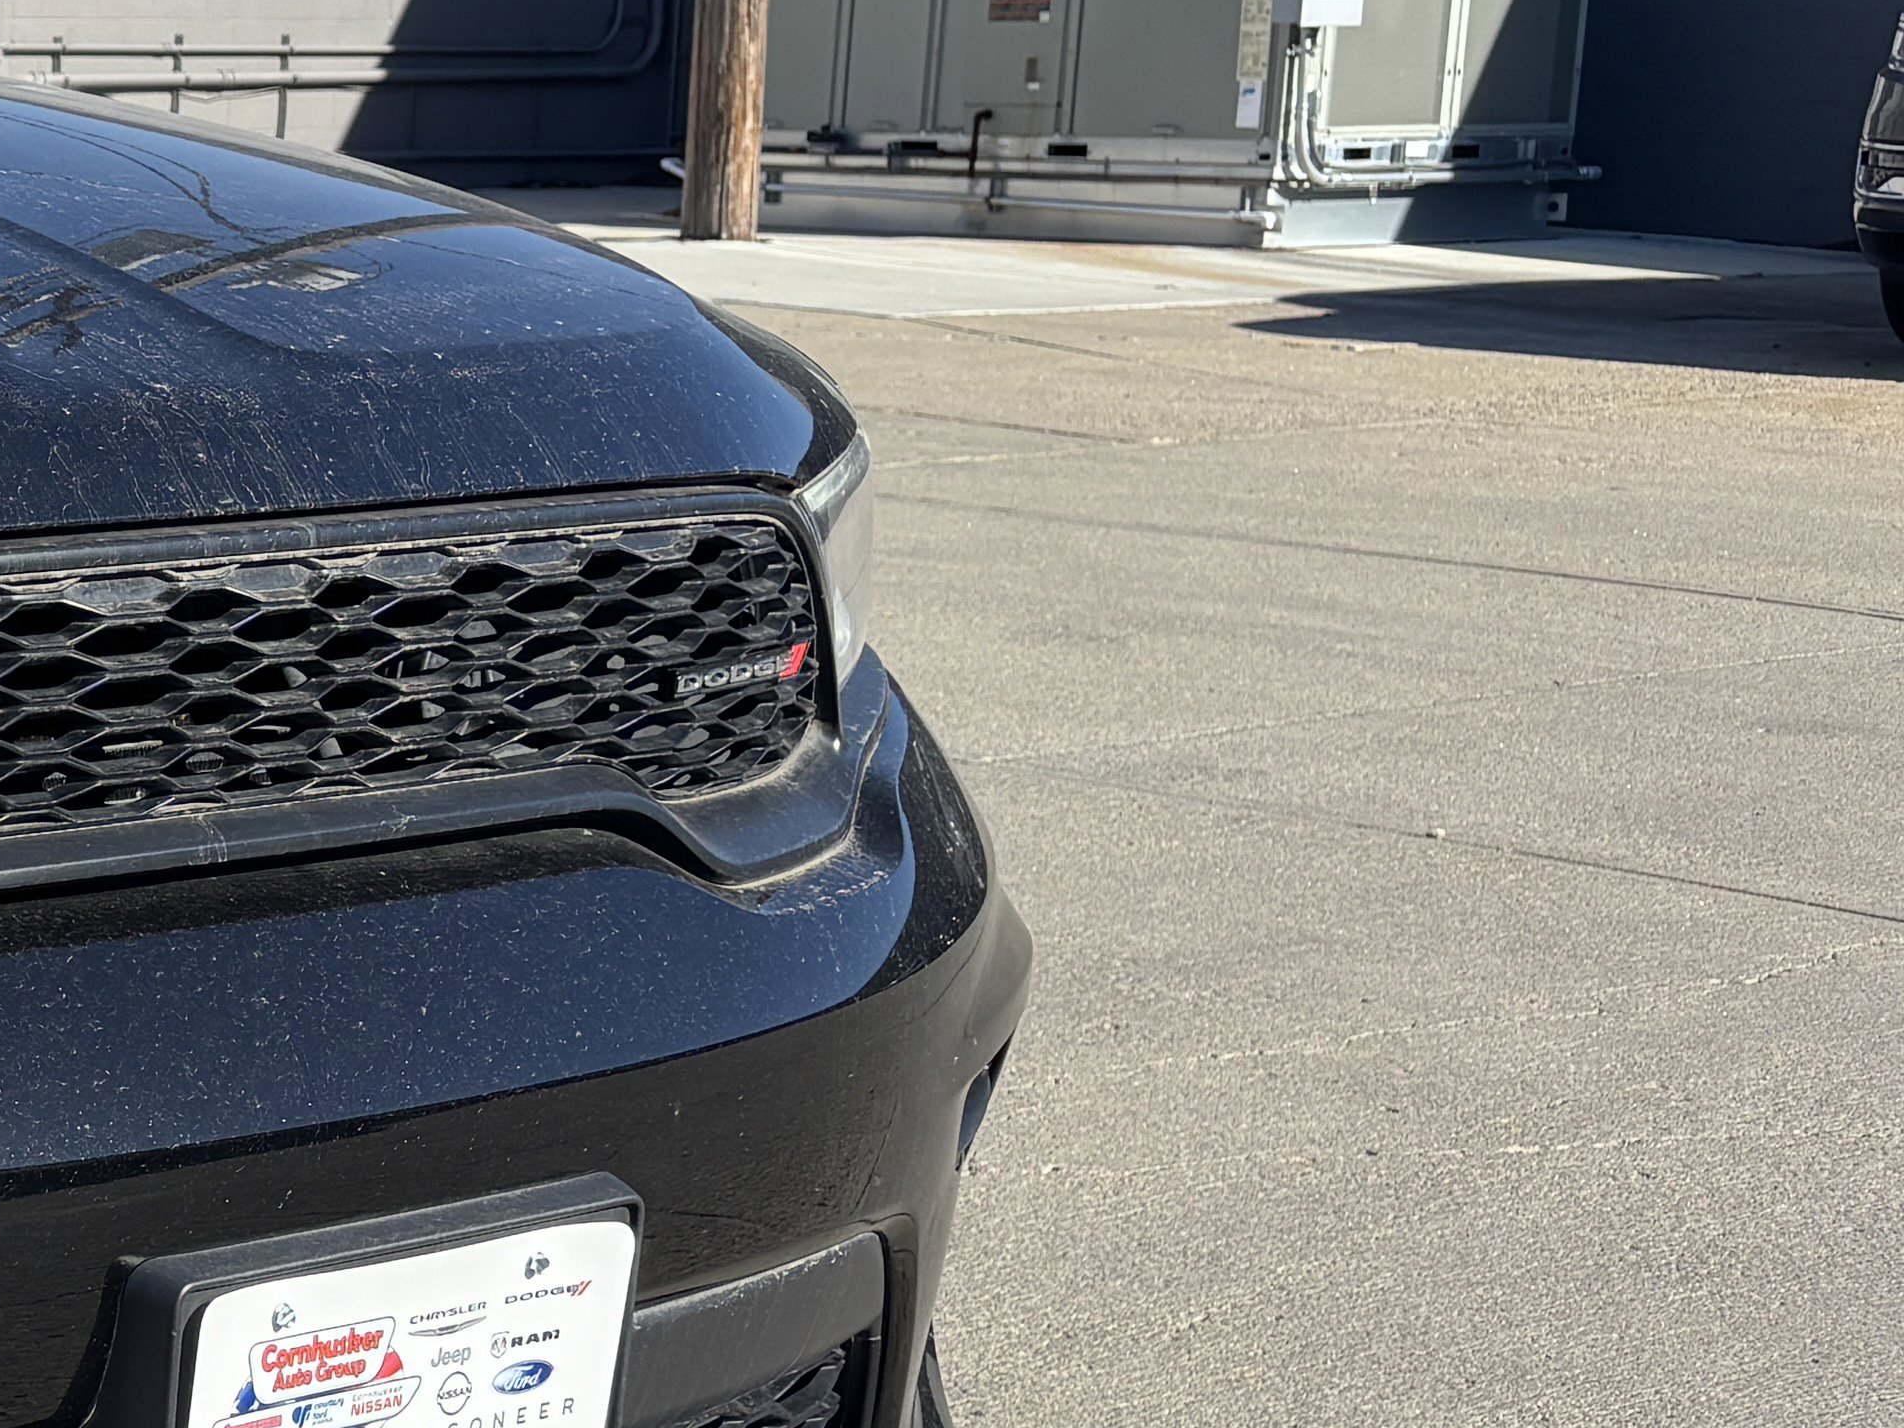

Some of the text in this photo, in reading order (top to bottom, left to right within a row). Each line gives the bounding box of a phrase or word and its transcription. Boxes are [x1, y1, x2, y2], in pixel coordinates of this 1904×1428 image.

[676, 650, 794, 694] DODGE
[504, 1282, 581, 1305] DODGE
[409, 1301, 487, 1325] CHRYSLER
[261, 1327, 384, 1373] Cornhusker
[510, 1329, 561, 1348] RAM
[431, 1346, 472, 1368] Jeep
[272, 1358, 366, 1393] Auto Group
[502, 1364, 543, 1392] Ford
[437, 1383, 472, 1400] NISSAN
[350, 1394, 403, 1416] NISSAN
